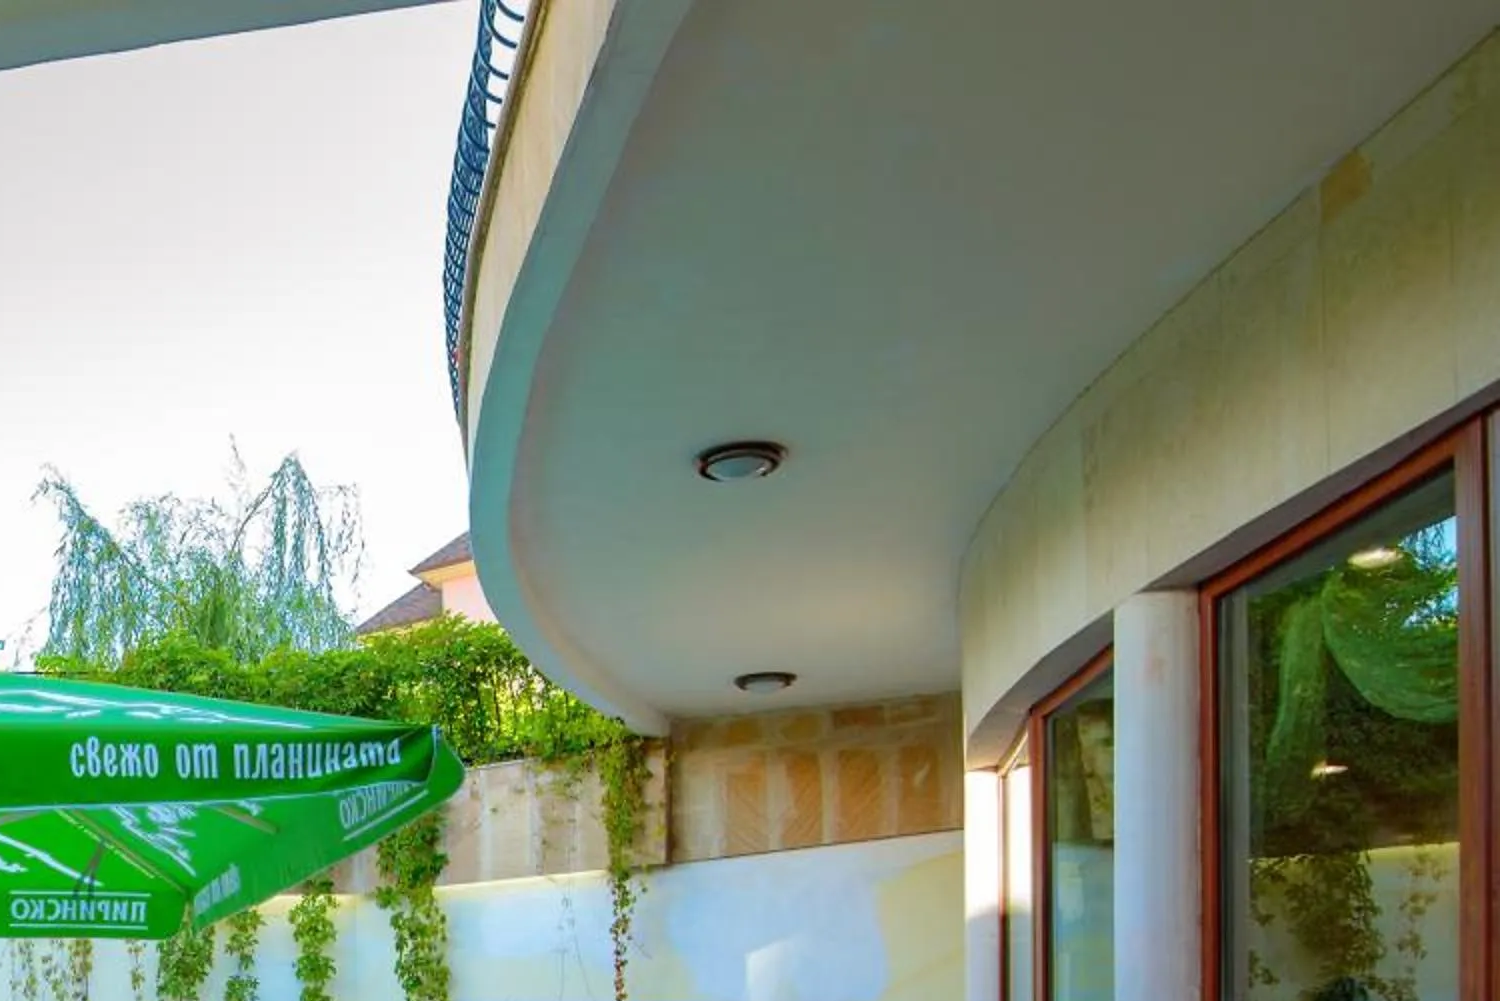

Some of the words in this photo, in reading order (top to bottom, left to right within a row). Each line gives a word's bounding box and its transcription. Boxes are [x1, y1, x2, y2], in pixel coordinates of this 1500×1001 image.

[70, 736, 159, 777] свежо
[175, 743, 218, 779] от
[234, 738, 400, 779] планината
